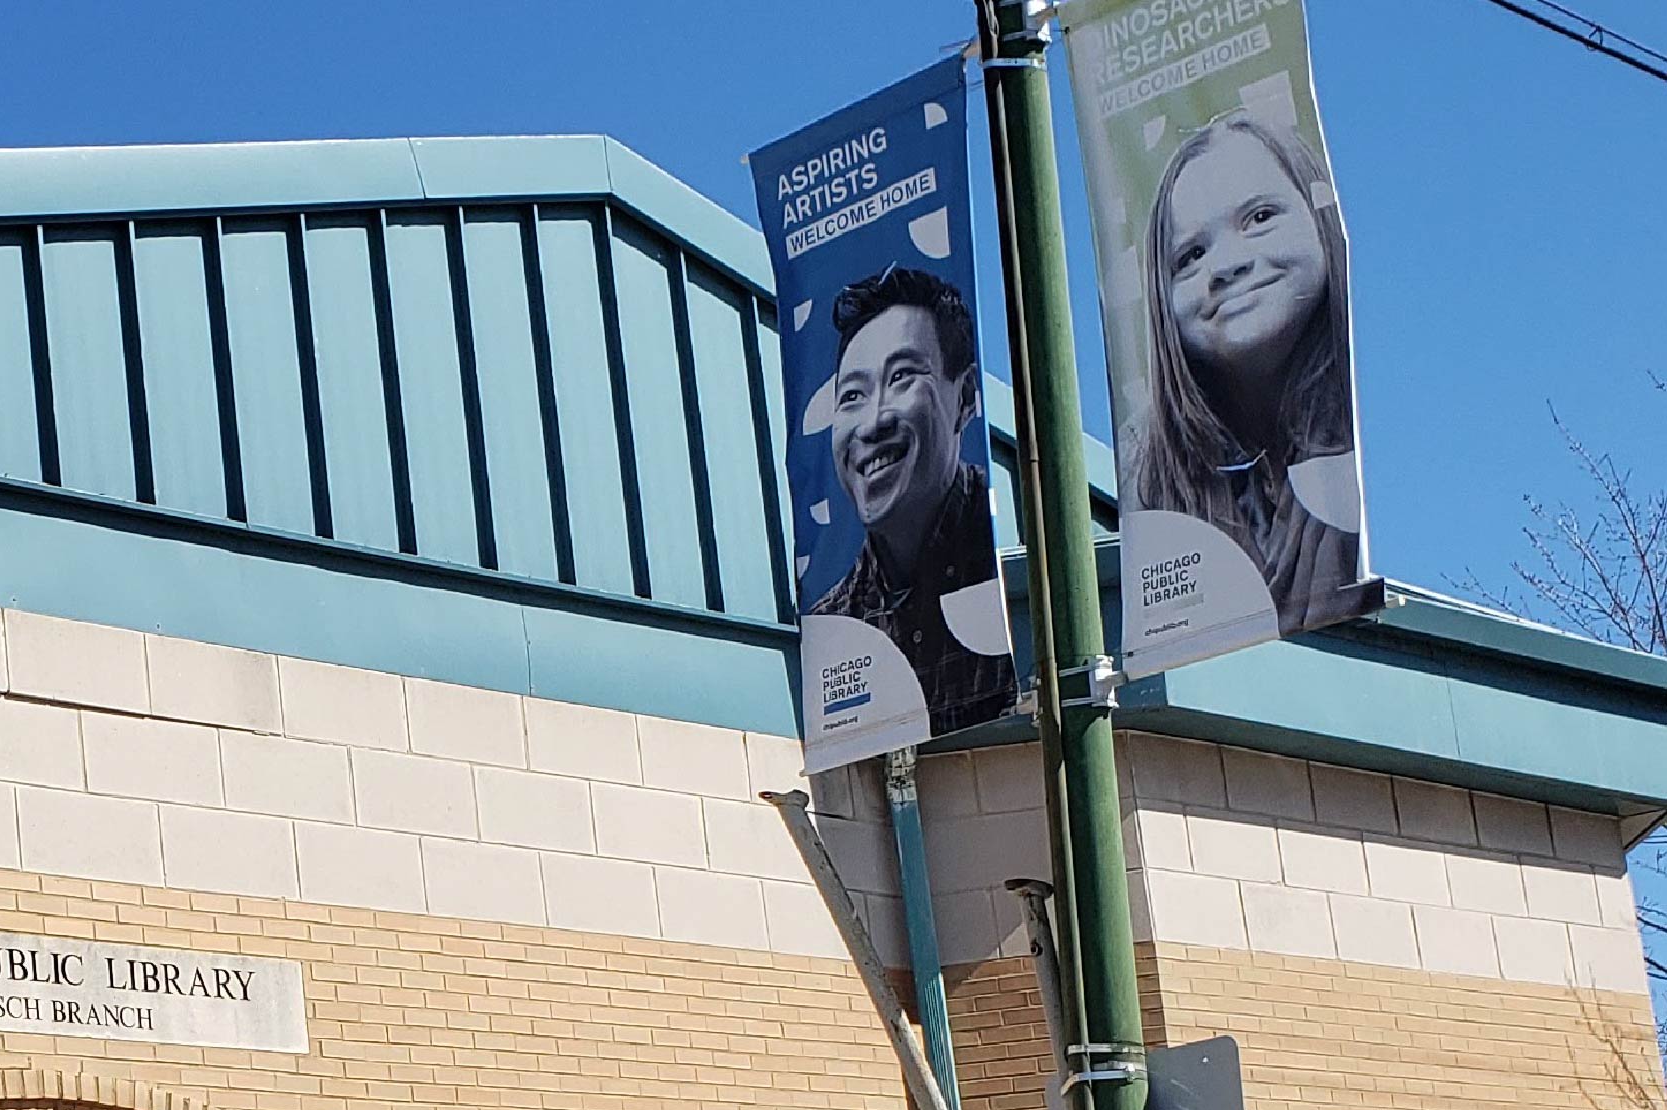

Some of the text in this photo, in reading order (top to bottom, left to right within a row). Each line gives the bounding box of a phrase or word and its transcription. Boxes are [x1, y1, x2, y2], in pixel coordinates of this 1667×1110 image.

[1100, 30, 1264, 113] WELCOME HOME
[778, 128, 887, 200] ASPIRING
[783, 163, 878, 229] ARTISTS
[790, 174, 931, 252] WELCOME HOME
[1141, 553, 1201, 579] CHICAGO
[1143, 570, 1188, 593] PUBLIC
[1144, 580, 1197, 606] LIBRARY
[822, 655, 872, 679] CHICAGO
[823, 671, 861, 691] PUBLIC
[824, 682, 868, 703] LIBRARY
[105, 957, 256, 1001] LIBRARY
[51, 1000, 154, 1030] BRANCH
